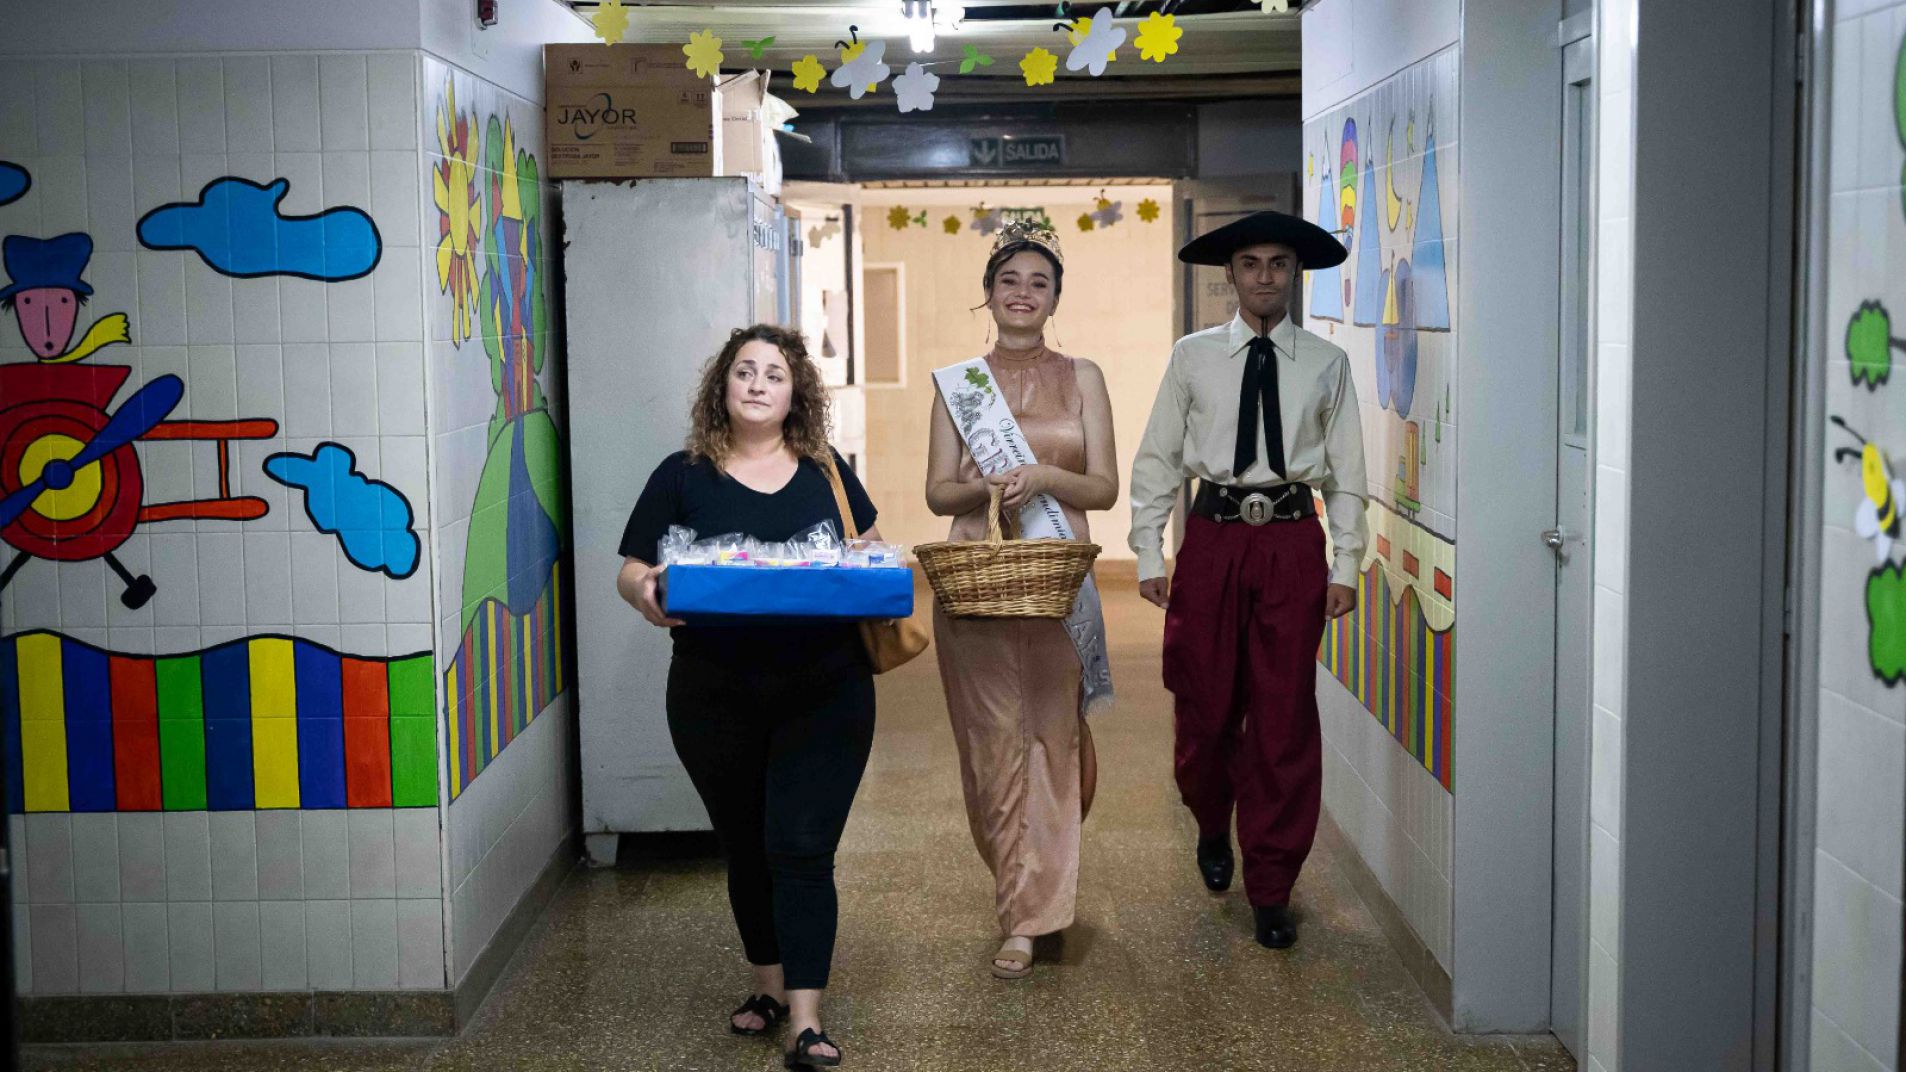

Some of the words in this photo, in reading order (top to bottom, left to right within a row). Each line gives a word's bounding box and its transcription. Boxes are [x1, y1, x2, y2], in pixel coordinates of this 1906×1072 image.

[558, 108, 637, 125] JAYOR
[1006, 143, 1059, 161] SALIDA
[1207, 282, 1236, 297] SERV
[999, 418, 1028, 465] Virrein
[1039, 494, 1067, 540] endimia
